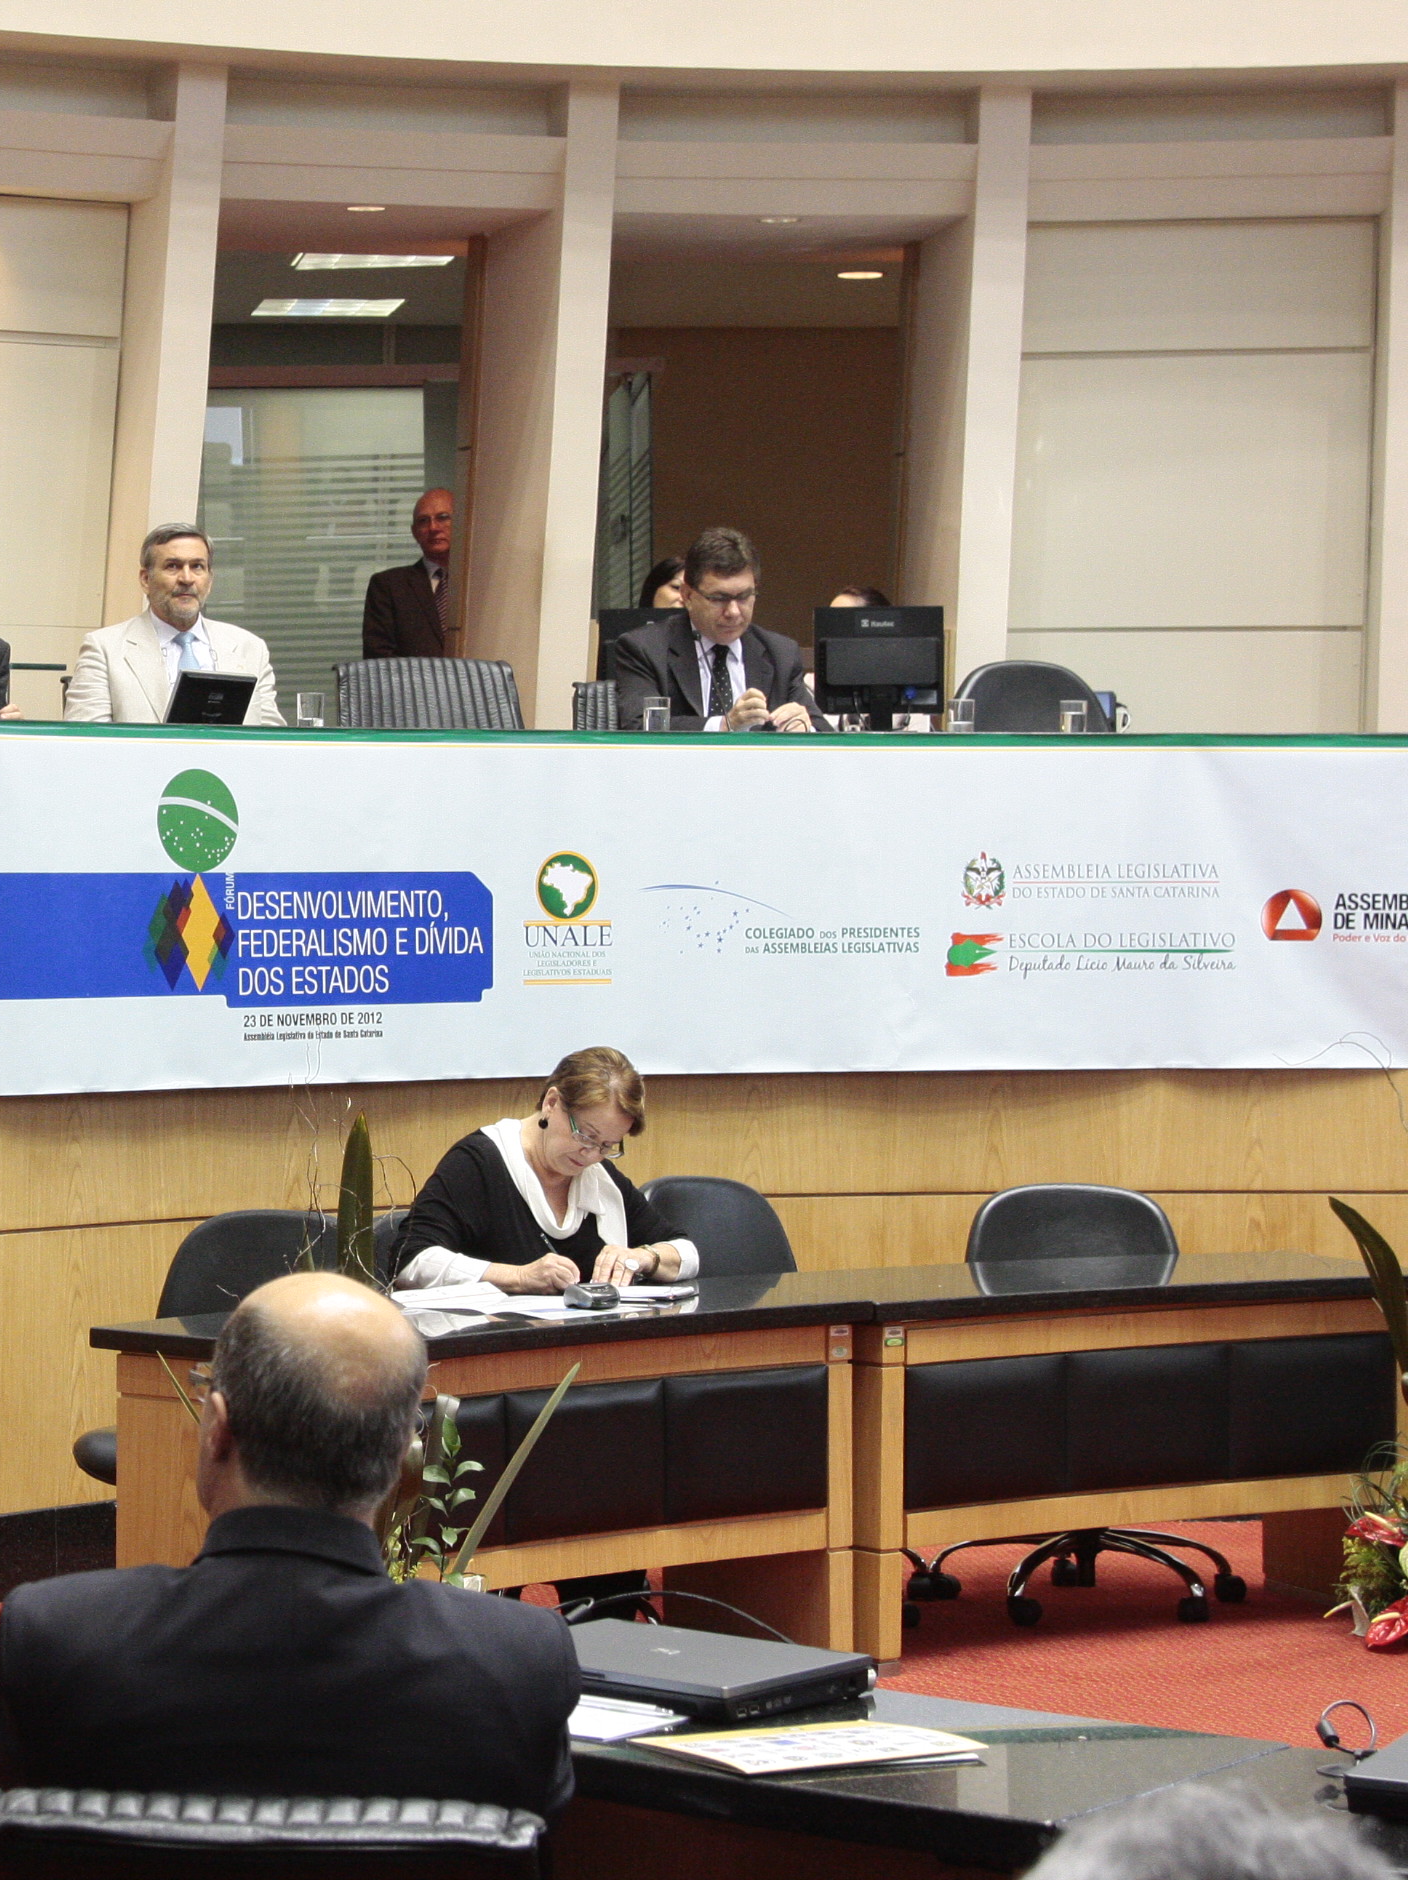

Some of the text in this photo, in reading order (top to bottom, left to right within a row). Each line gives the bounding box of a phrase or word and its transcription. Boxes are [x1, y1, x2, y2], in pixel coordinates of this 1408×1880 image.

[1012, 863, 1220, 879] ASSEMBLEIA LEGISLATIVA
[224, 872, 235, 910] FÓRUM
[1012, 886, 1220, 899] DO ESTADO DE SANTA CATARINA
[237, 889, 449, 923] DESENVOLVIMENTO,
[1334, 893, 1408, 911] ASSEMB
[1333, 912, 1408, 930] DE MINA
[238, 921, 484, 958] FEDERALISMO E DÍVIDA
[523, 925, 613, 948] UNALE
[745, 927, 920, 940] COLEGIADO DOS PRESIDENTES
[1008, 932, 1236, 948] ESCOLA DO LEGISLATIVO
[1332, 933, 1361, 942] Poder
[1373, 933, 1390, 942] Voz
[1393, 933, 1407, 942] do
[528, 950, 606, 958] UNIÃO NACIONAL DOS
[745, 942, 920, 954] DAS ASSEMBLEIAS LEGISLATIVAS
[537, 959, 597, 967] LEGISLADORES E
[1008, 953, 1237, 980] Deputado Lício Mauro da Silveira
[238, 965, 390, 996] DOS ESTADOS
[523, 968, 613, 977] LEGISLATIVOS ESTADUAIS
[243, 1012, 383, 1028] 23 DE NOVEMBRO DE 2012
[276, 1030, 306, 1042] Legislativa
[315, 1029, 333, 1040] Estado
[335, 1029, 341, 1039] de
[343, 1029, 359, 1039] Santa
[360, 1028, 383, 1038] Catarina
